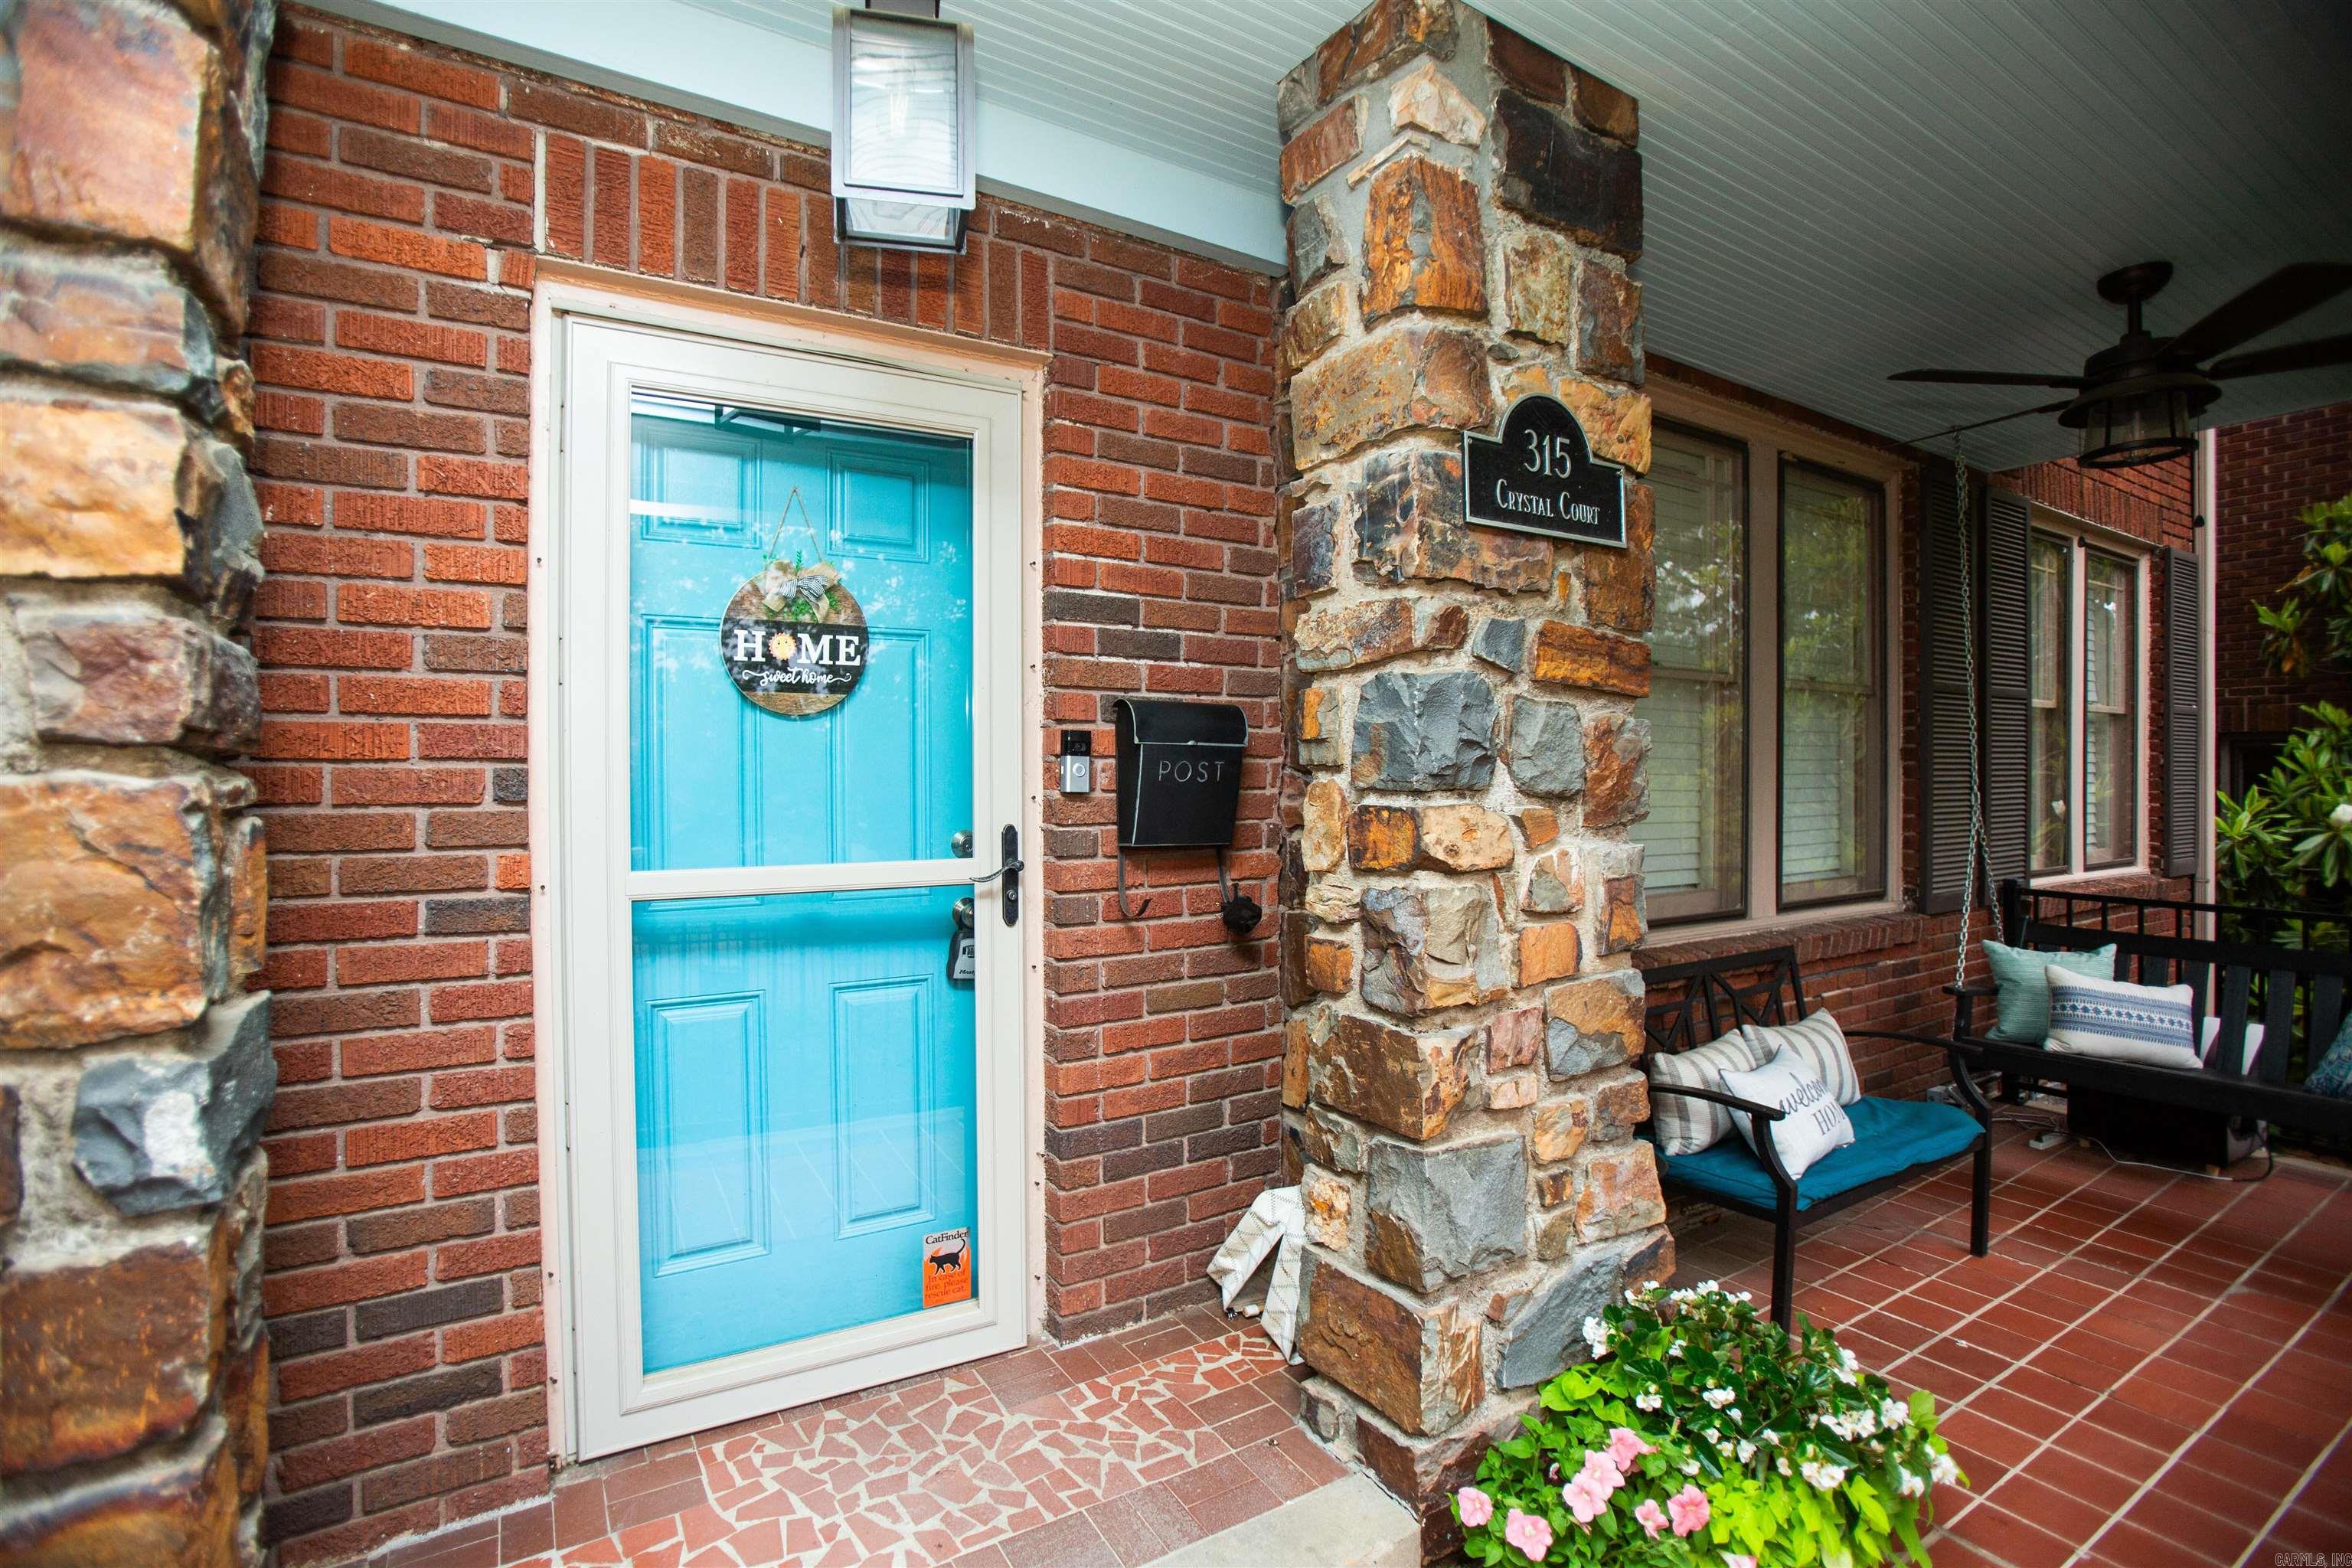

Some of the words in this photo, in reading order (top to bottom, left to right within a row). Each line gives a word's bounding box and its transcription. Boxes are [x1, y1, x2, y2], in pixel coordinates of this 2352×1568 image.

[1524, 429, 1572, 479] 315
[742, 666, 801, 687] sweet
[801, 666, 851, 684] home
[1158, 760, 1225, 782] POST
[1811, 1102, 1846, 1135] HOM
[926, 1230, 969, 1245] CatFinder
